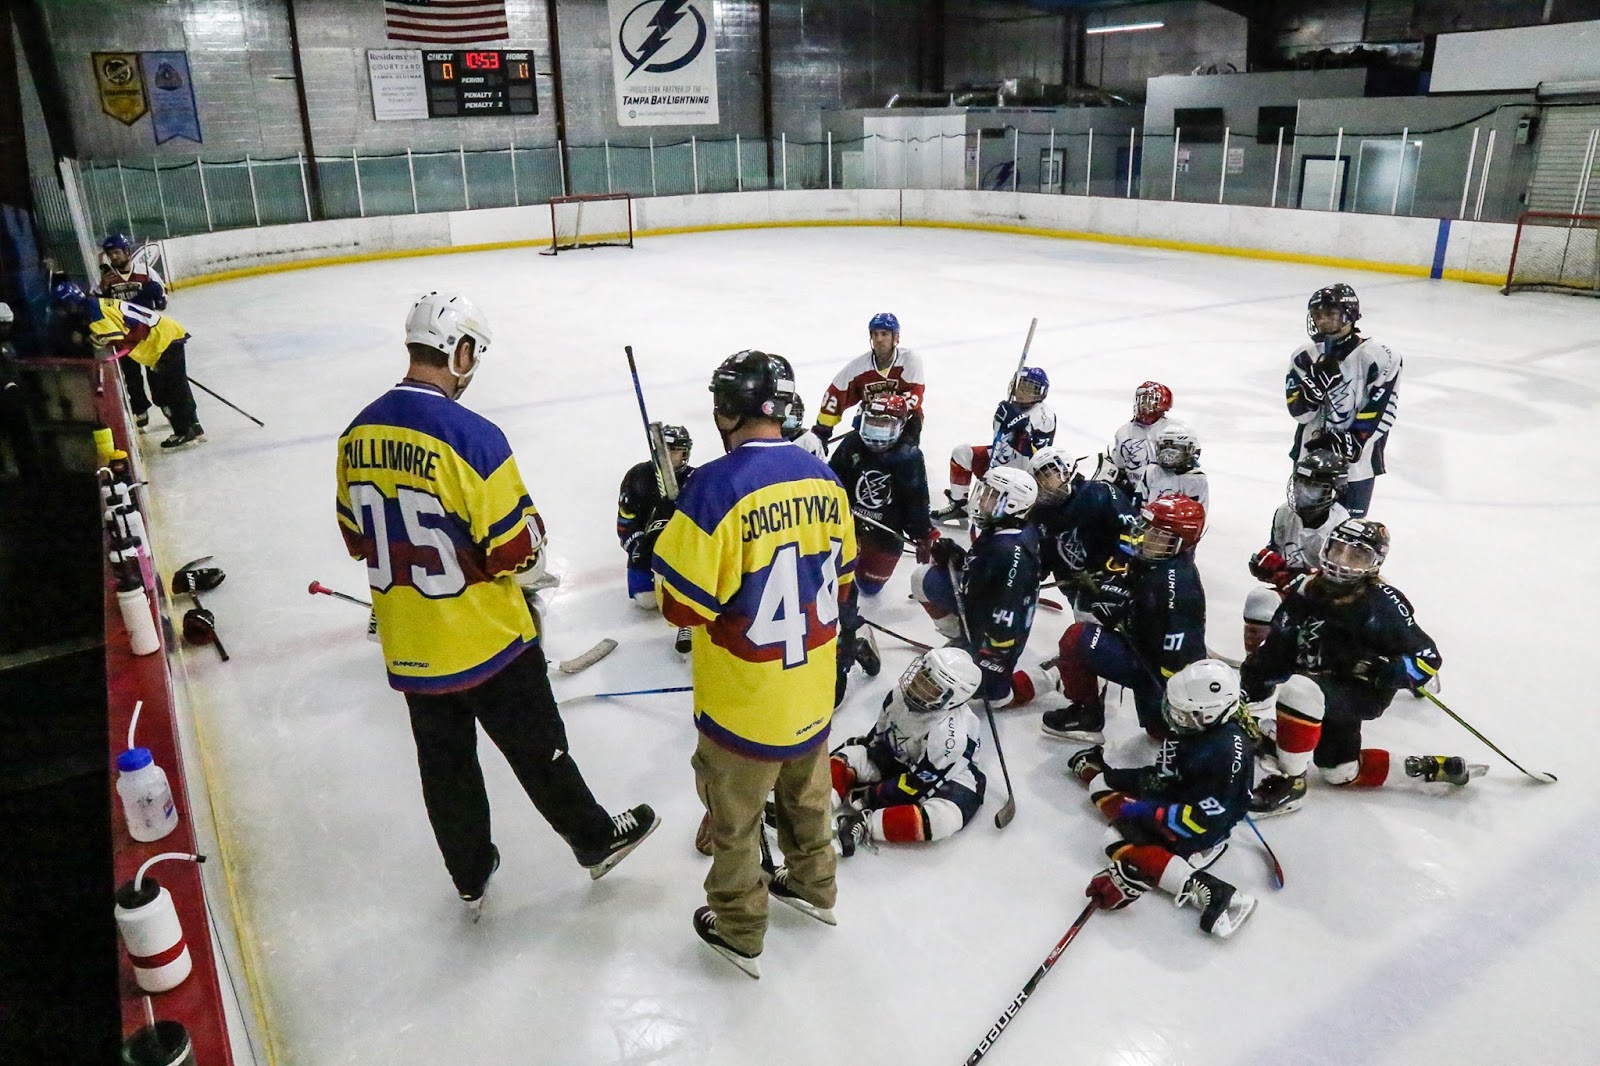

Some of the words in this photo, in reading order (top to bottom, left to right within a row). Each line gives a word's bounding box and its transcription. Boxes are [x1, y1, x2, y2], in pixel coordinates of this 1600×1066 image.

[442, 63, 453, 79] 0
[629, 86, 647, 94] PROUD
[1007, 545, 1021, 588] KUMON
[1168, 569, 1176, 609] KUMON
[1376, 583, 1414, 627] KUMON
[992, 606, 1014, 628] 44
[1163, 632, 1185, 651] 07
[944, 717, 956, 758] KUMON
[1231, 734, 1243, 783] KUMO
[1198, 796, 1226, 816] 87
[977, 990, 1028, 1055] BAUER
